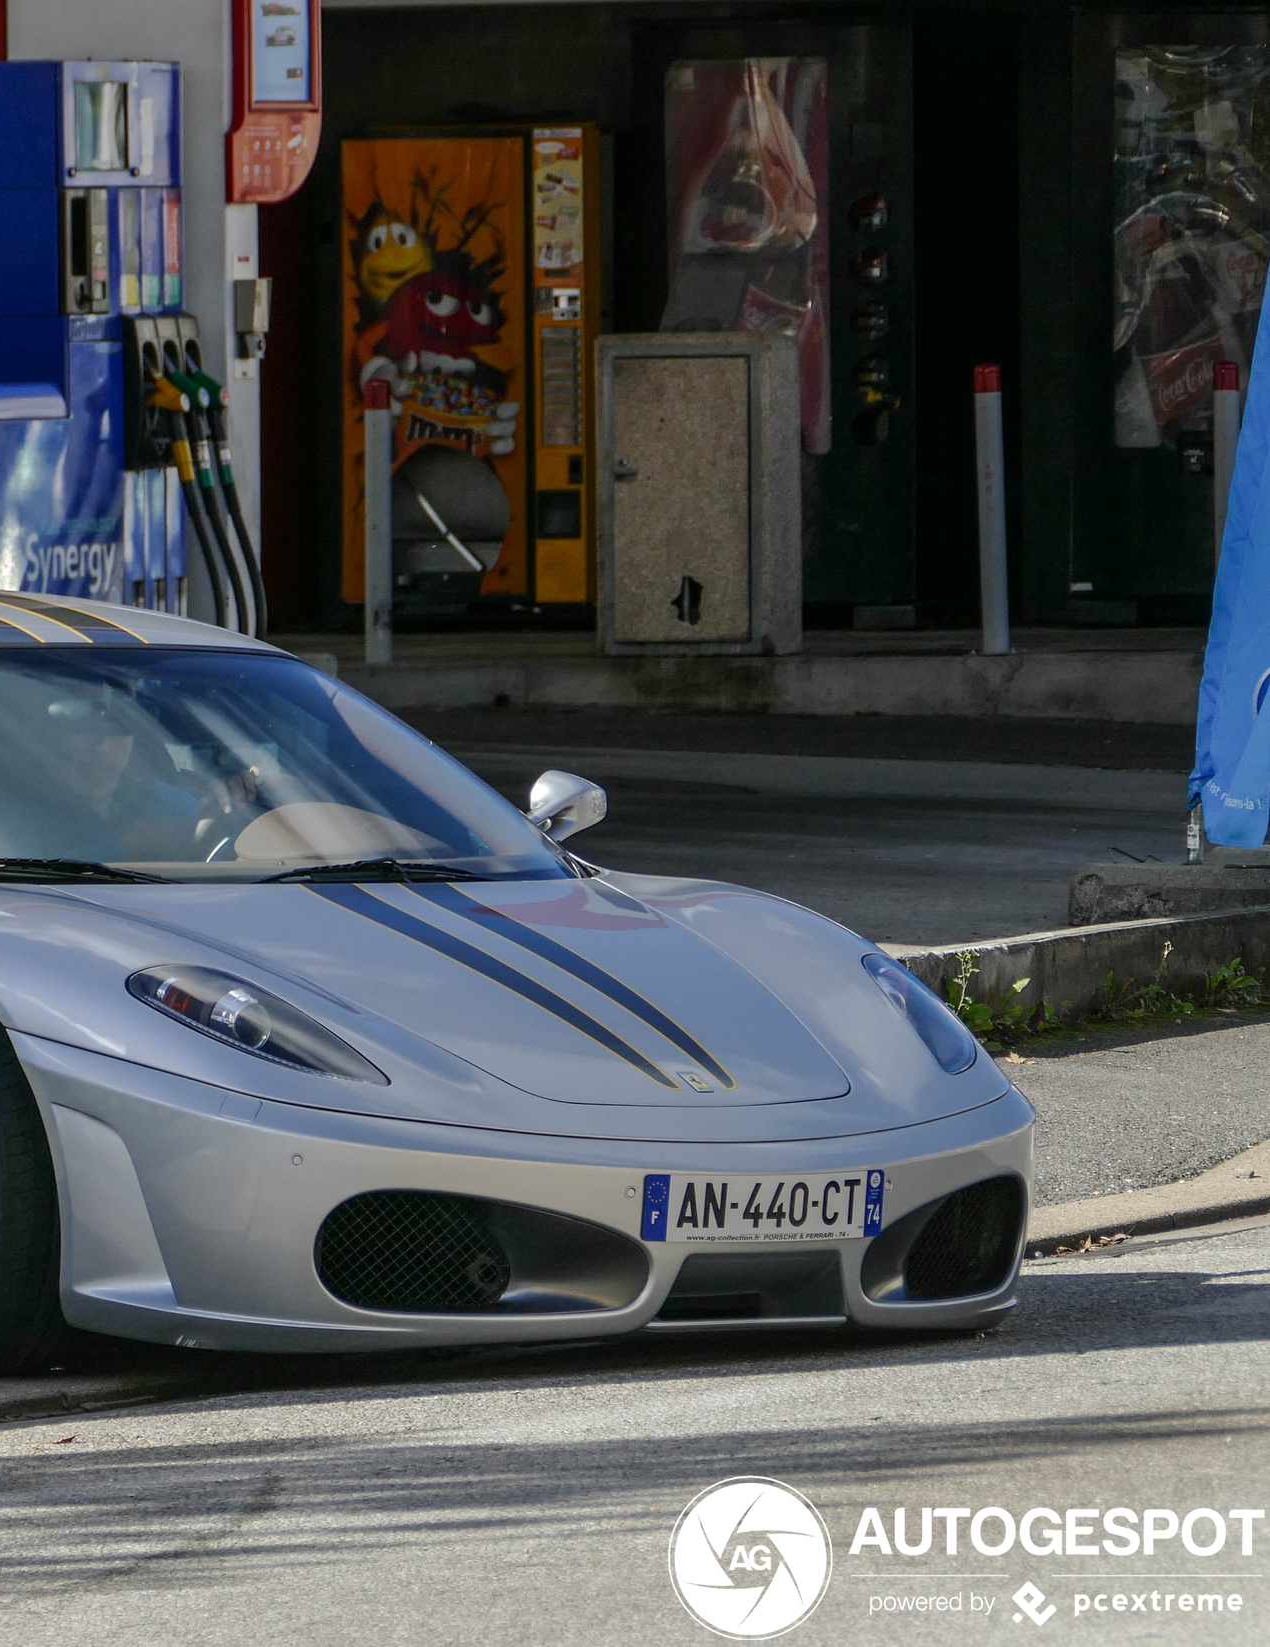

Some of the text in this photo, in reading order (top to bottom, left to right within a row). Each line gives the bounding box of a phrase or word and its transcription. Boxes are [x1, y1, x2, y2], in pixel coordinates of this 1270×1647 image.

[26, 532, 117, 594] Synergy
[676, 1178, 862, 1229] AN-440-CT
[867, 1203, 880, 1225] 74
[651, 1211, 660, 1225] F
[763, 1233, 798, 1241] PORSCHE
[805, 1232, 835, 1240] FERRARI
